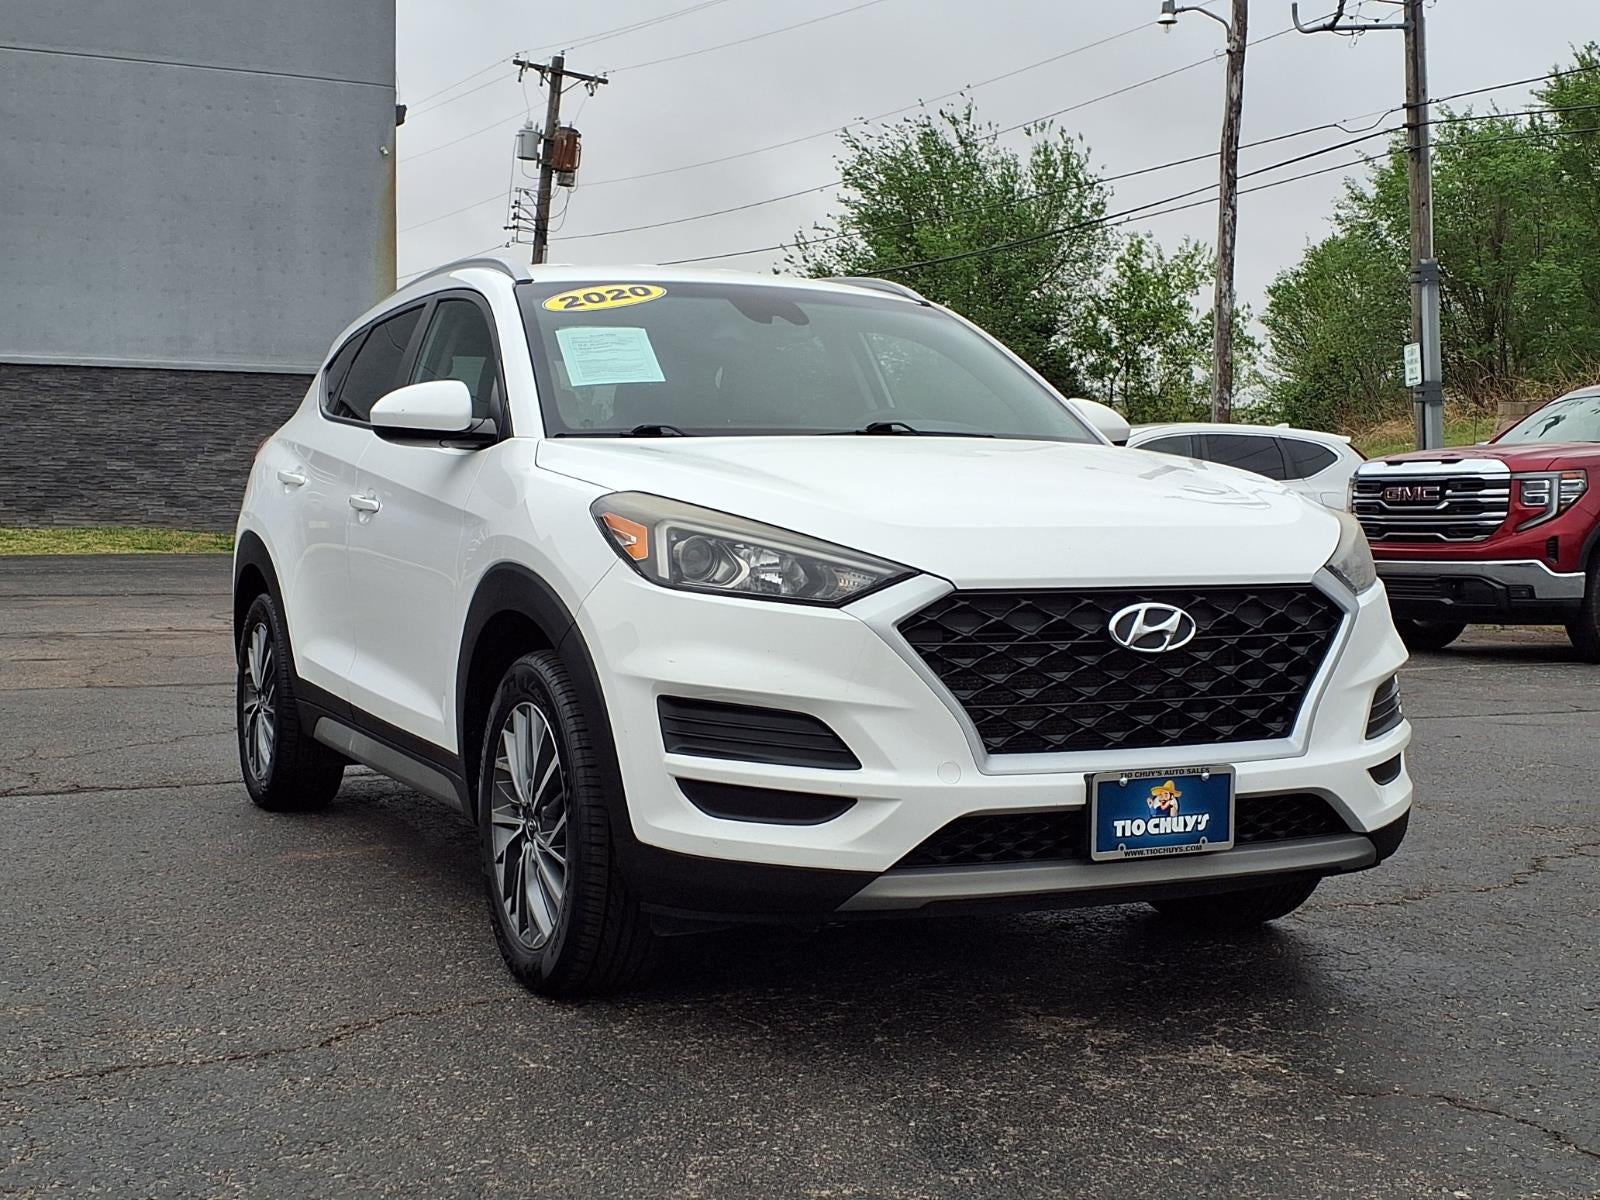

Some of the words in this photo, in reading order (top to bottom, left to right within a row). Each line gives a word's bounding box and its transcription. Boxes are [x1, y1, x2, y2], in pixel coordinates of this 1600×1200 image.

[559, 286, 652, 309] 2020
[1384, 486, 1440, 501] GMC
[1134, 770, 1162, 778] CHUY'S
